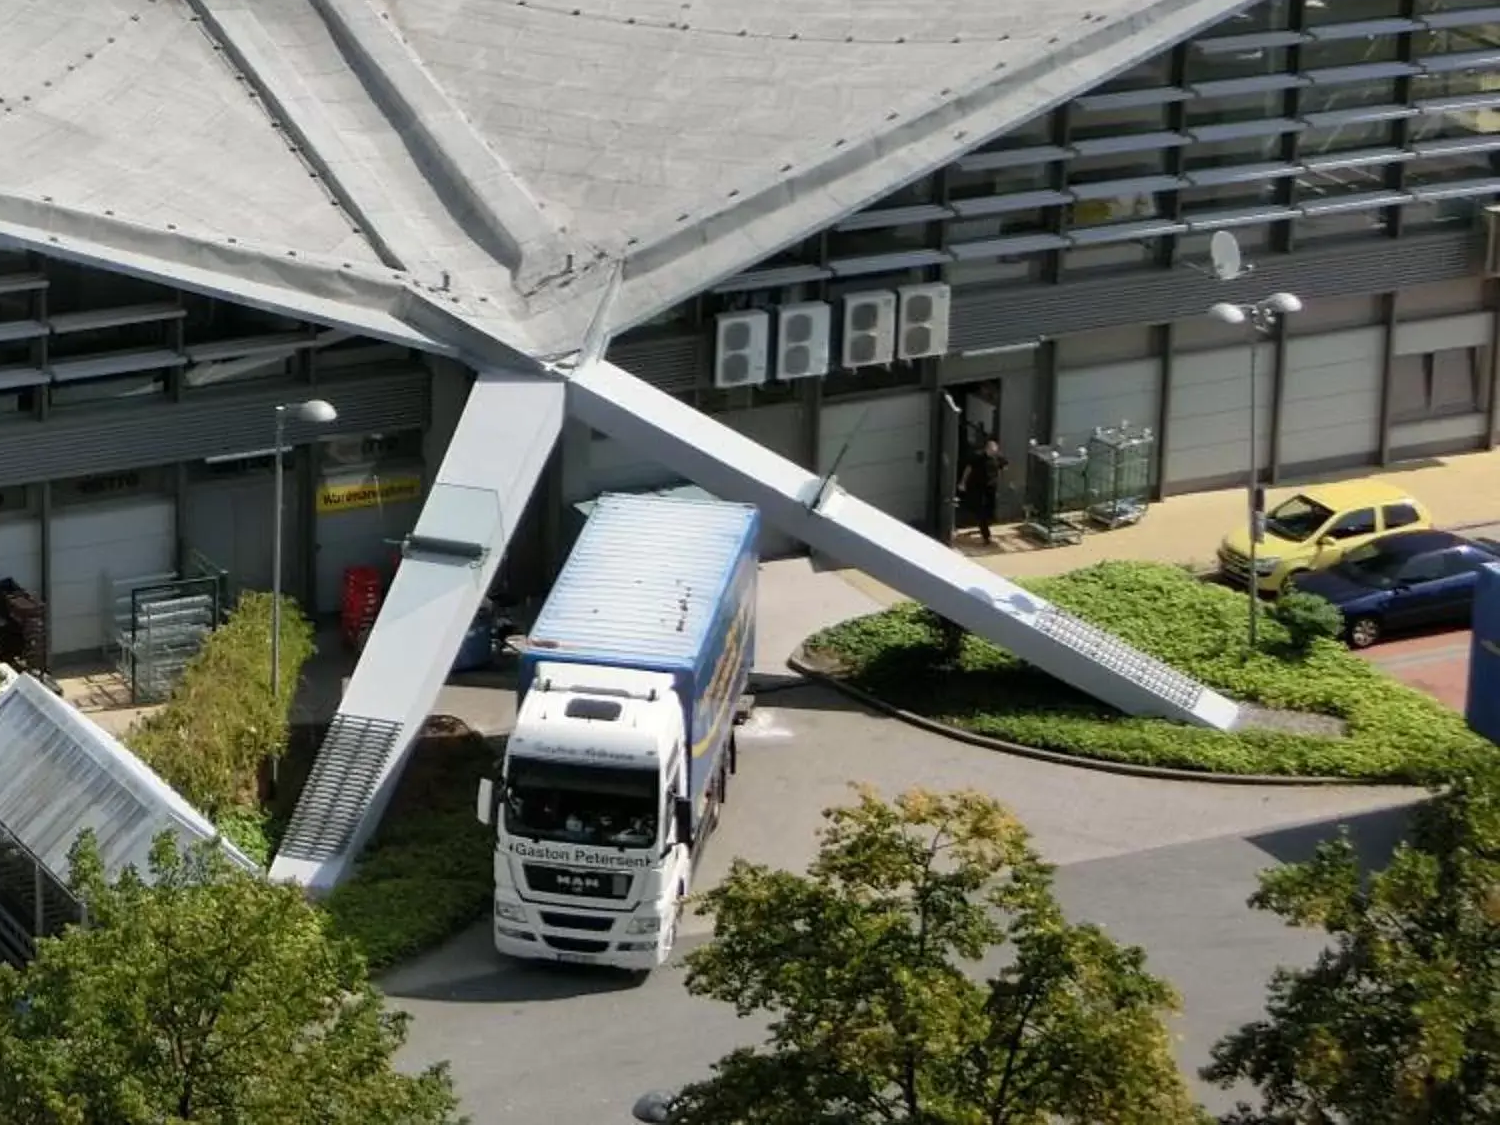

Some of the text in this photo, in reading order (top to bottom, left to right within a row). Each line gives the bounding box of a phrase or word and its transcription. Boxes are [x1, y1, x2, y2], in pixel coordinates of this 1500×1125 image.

[515, 842, 645, 868] Gaston Petersen
[556, 874, 600, 888] MAN
